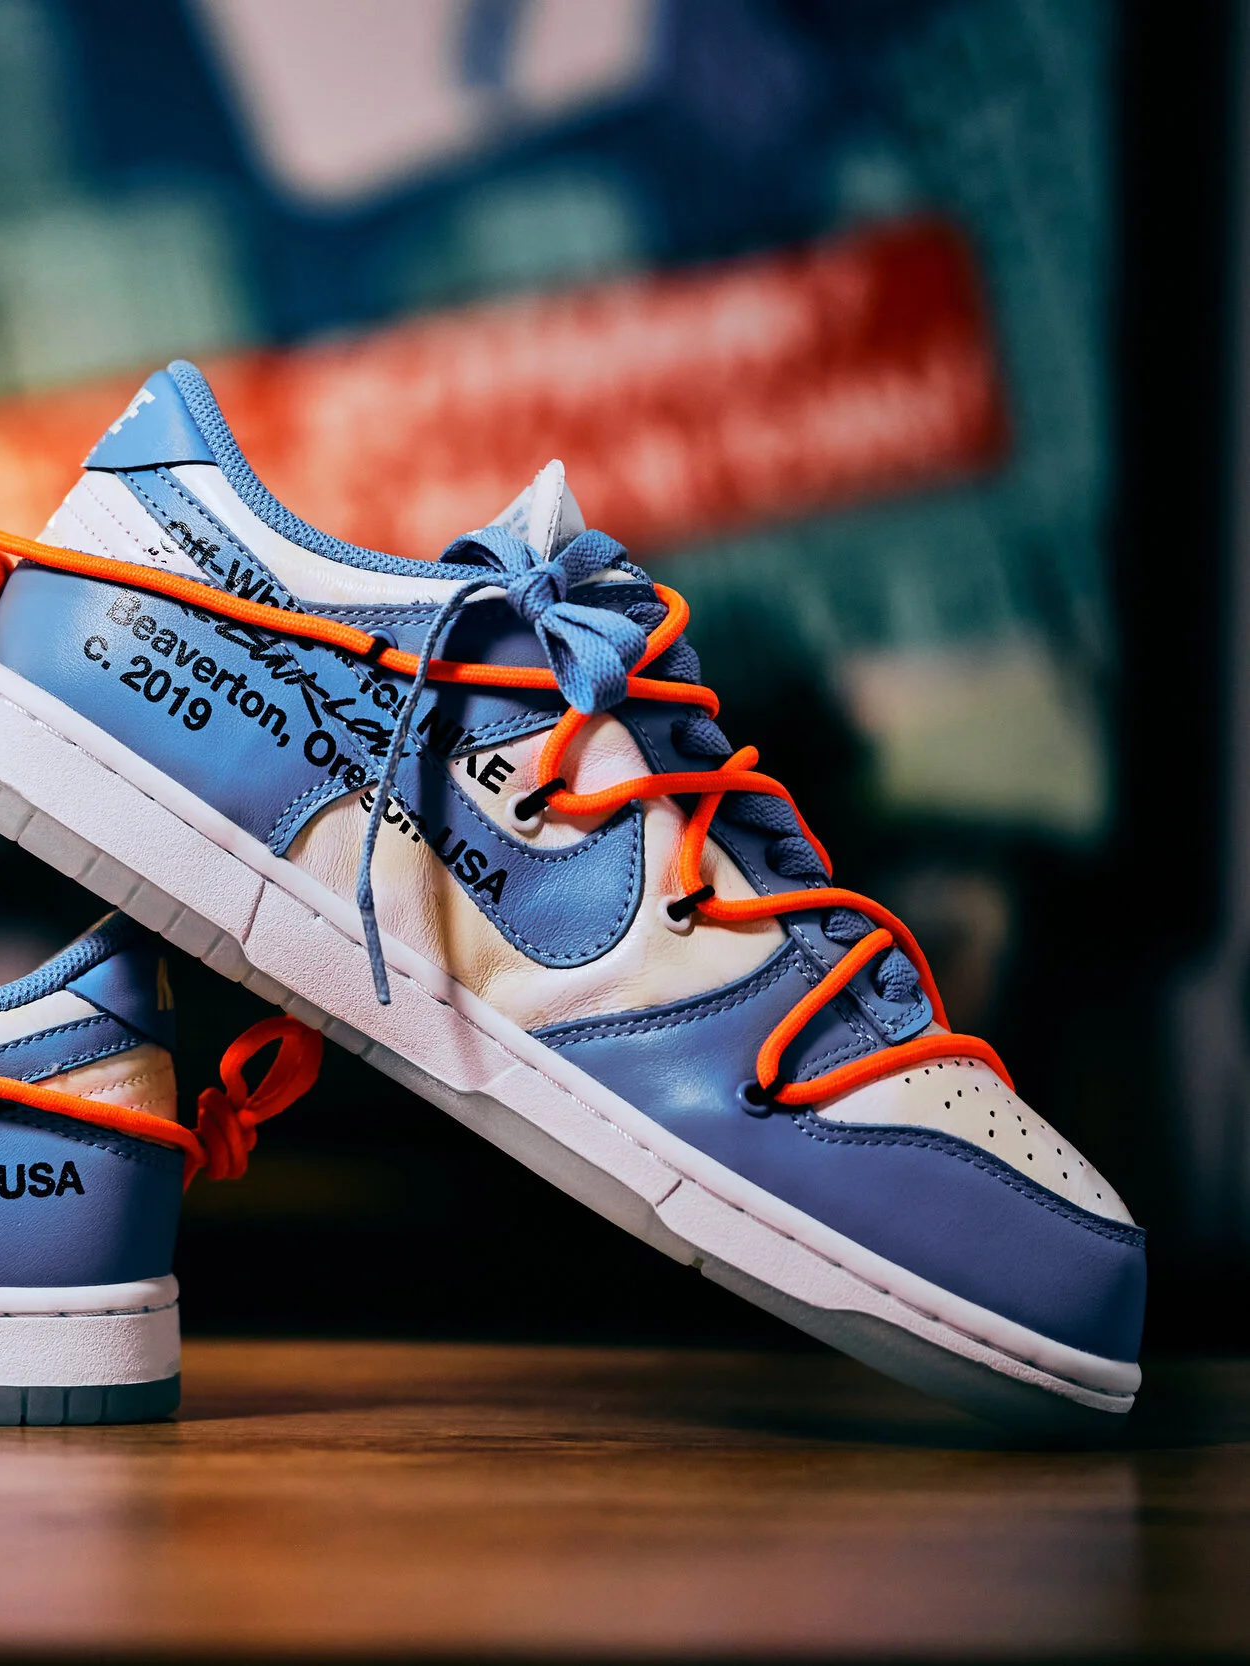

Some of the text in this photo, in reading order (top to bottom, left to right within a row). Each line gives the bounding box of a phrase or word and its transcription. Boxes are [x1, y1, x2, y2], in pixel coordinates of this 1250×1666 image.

[83, 635, 212, 731] c. 2019
[106, 588, 291, 747] Beaverton,
[433, 826, 508, 905] USA
